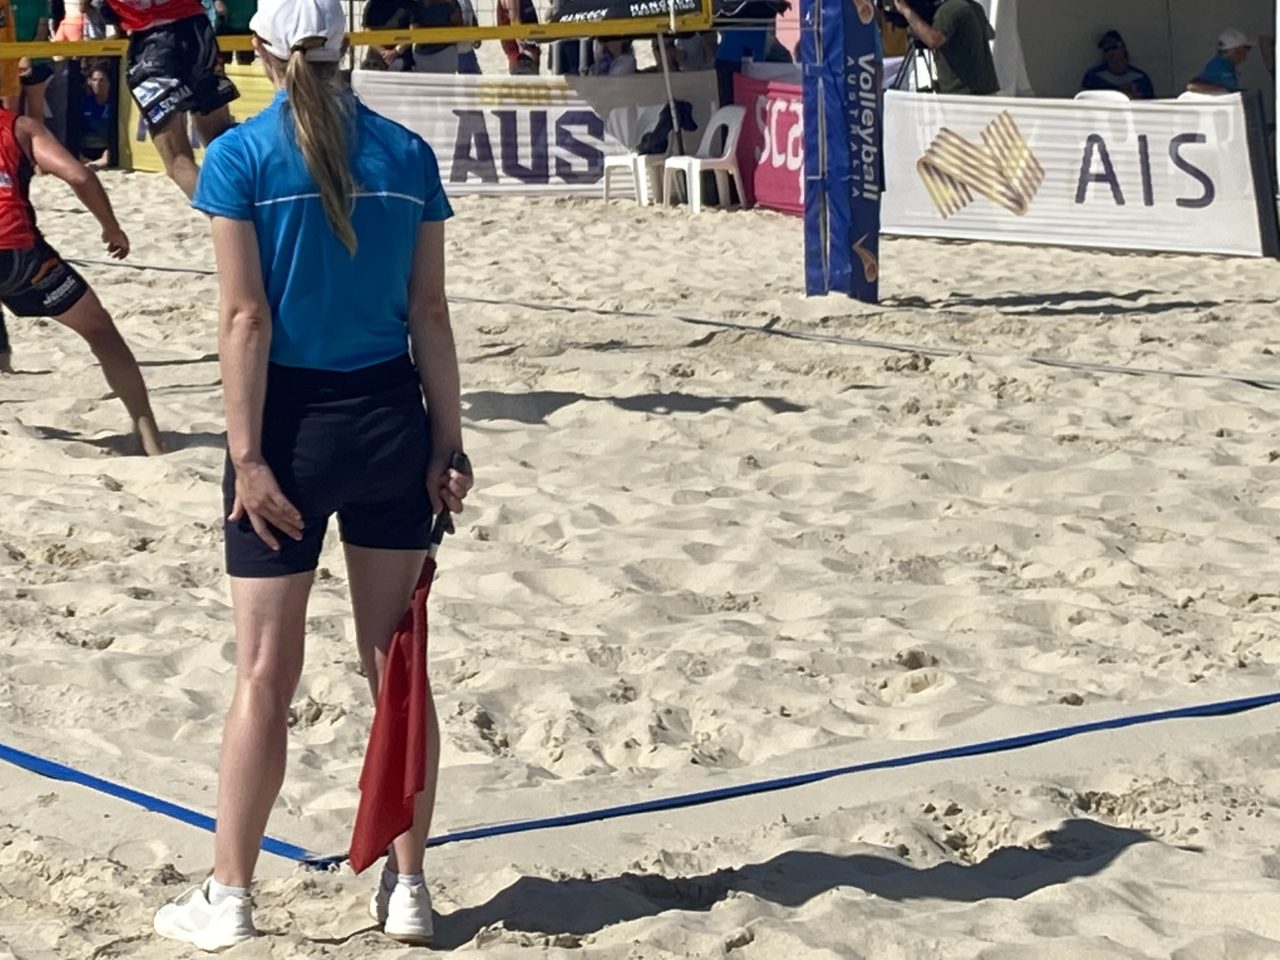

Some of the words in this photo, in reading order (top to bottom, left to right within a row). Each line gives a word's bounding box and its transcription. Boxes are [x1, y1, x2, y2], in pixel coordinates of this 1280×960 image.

[450, 109, 606, 185] AUS
[846, 55, 861, 198] AUSTRALIA
[857, 52, 879, 201] Volleyball
[1074, 132, 1216, 209] AIS
